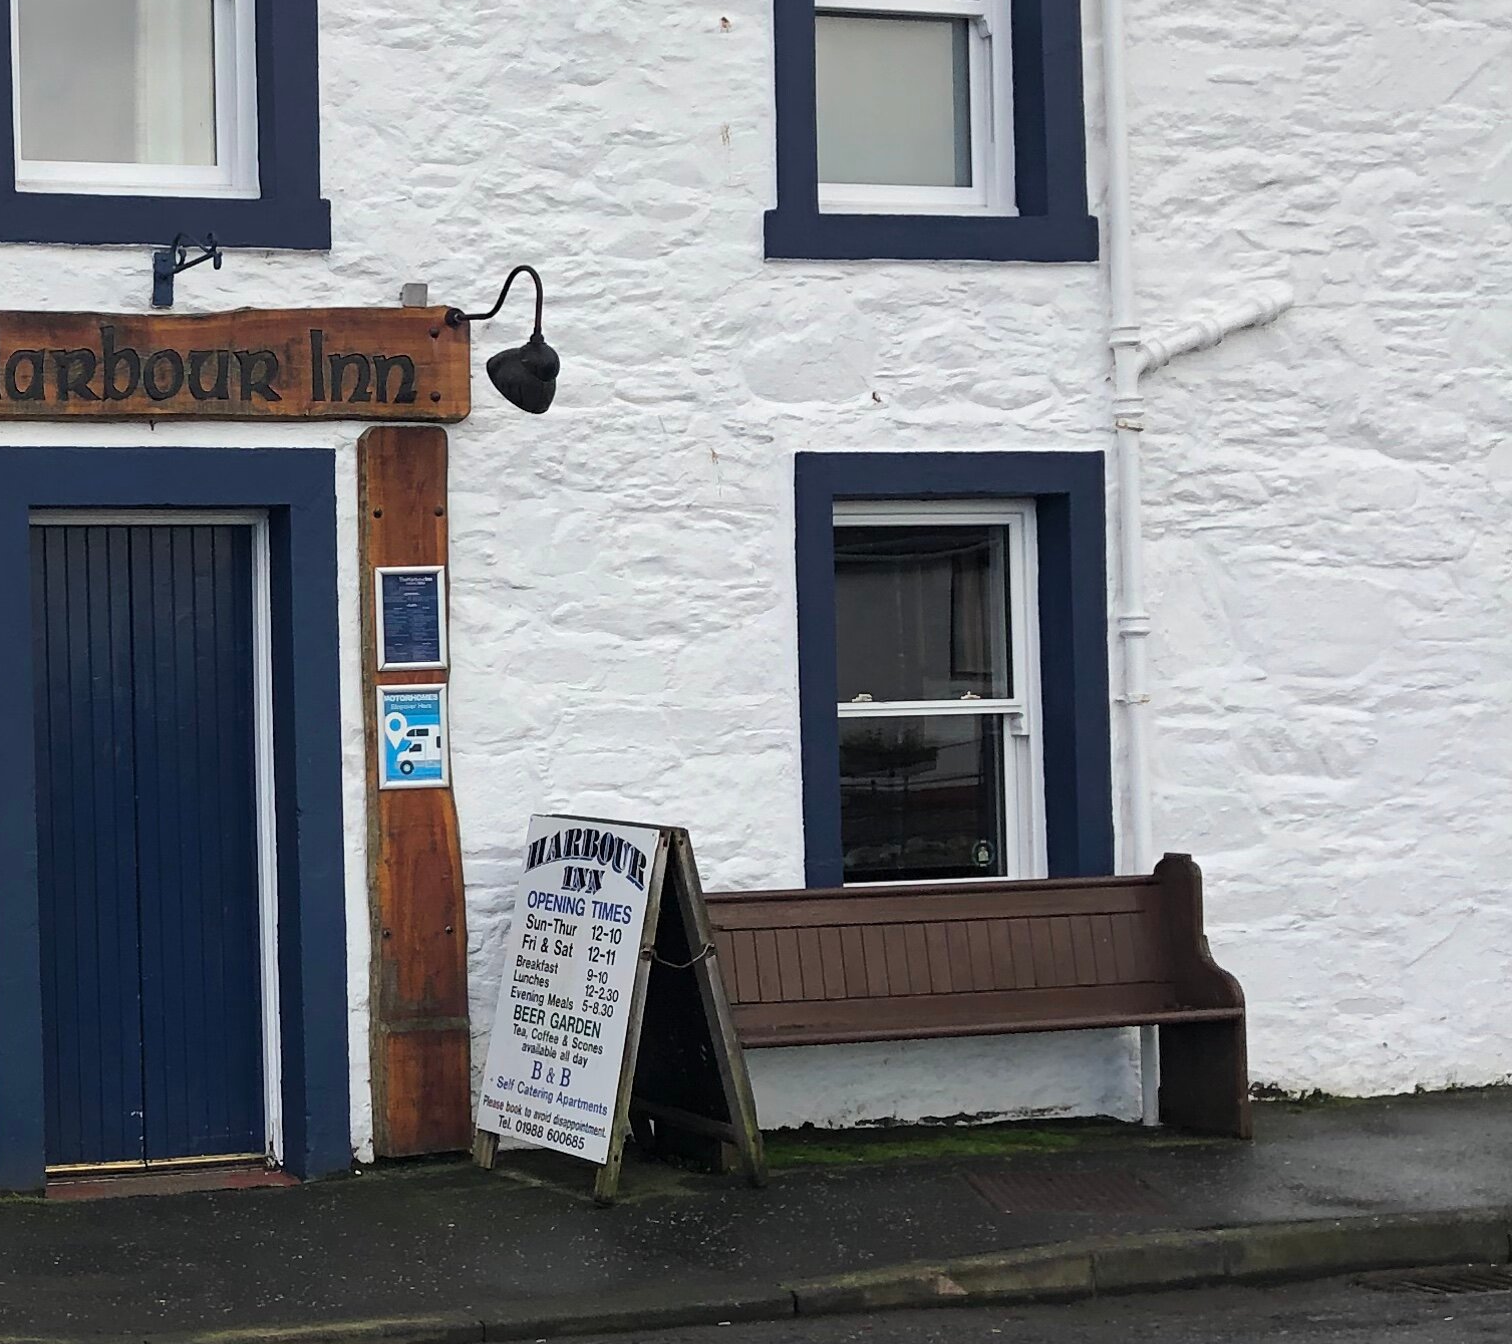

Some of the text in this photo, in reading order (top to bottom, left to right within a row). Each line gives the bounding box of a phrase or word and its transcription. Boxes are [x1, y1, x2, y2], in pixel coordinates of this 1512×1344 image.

[310, 328, 418, 404] Inn
[524, 828, 647, 891] HARBOUR
[561, 866, 605, 895] INN
[527, 890, 632, 924] OPENING TIMES
[526, 913, 622, 945] Sun-Thur 12-10
[521, 934, 616, 966] Fri & Sat 12-11
[513, 969, 619, 1002] Lunches 12-2.30
[516, 955, 608, 984] Breakfast 9-10
[510, 985, 614, 1018] Evening Meals 5-8.30
[513, 1004, 601, 1038] BEER GARDEN
[513, 1023, 603, 1055] Tea, Coffee & Scones
[521, 1042, 589, 1068] available all day
[531, 1060, 572, 1088] B & B
[483, 1094, 504, 1111] Please
[505, 1101, 522, 1115] book
[524, 1106, 532, 1118] to
[533, 1111, 552, 1123] avoid
[496, 1076, 608, 1116] Self Catering Apartments
[515, 1120, 544, 1138] 01988
[546, 1128, 585, 1150] 600685
